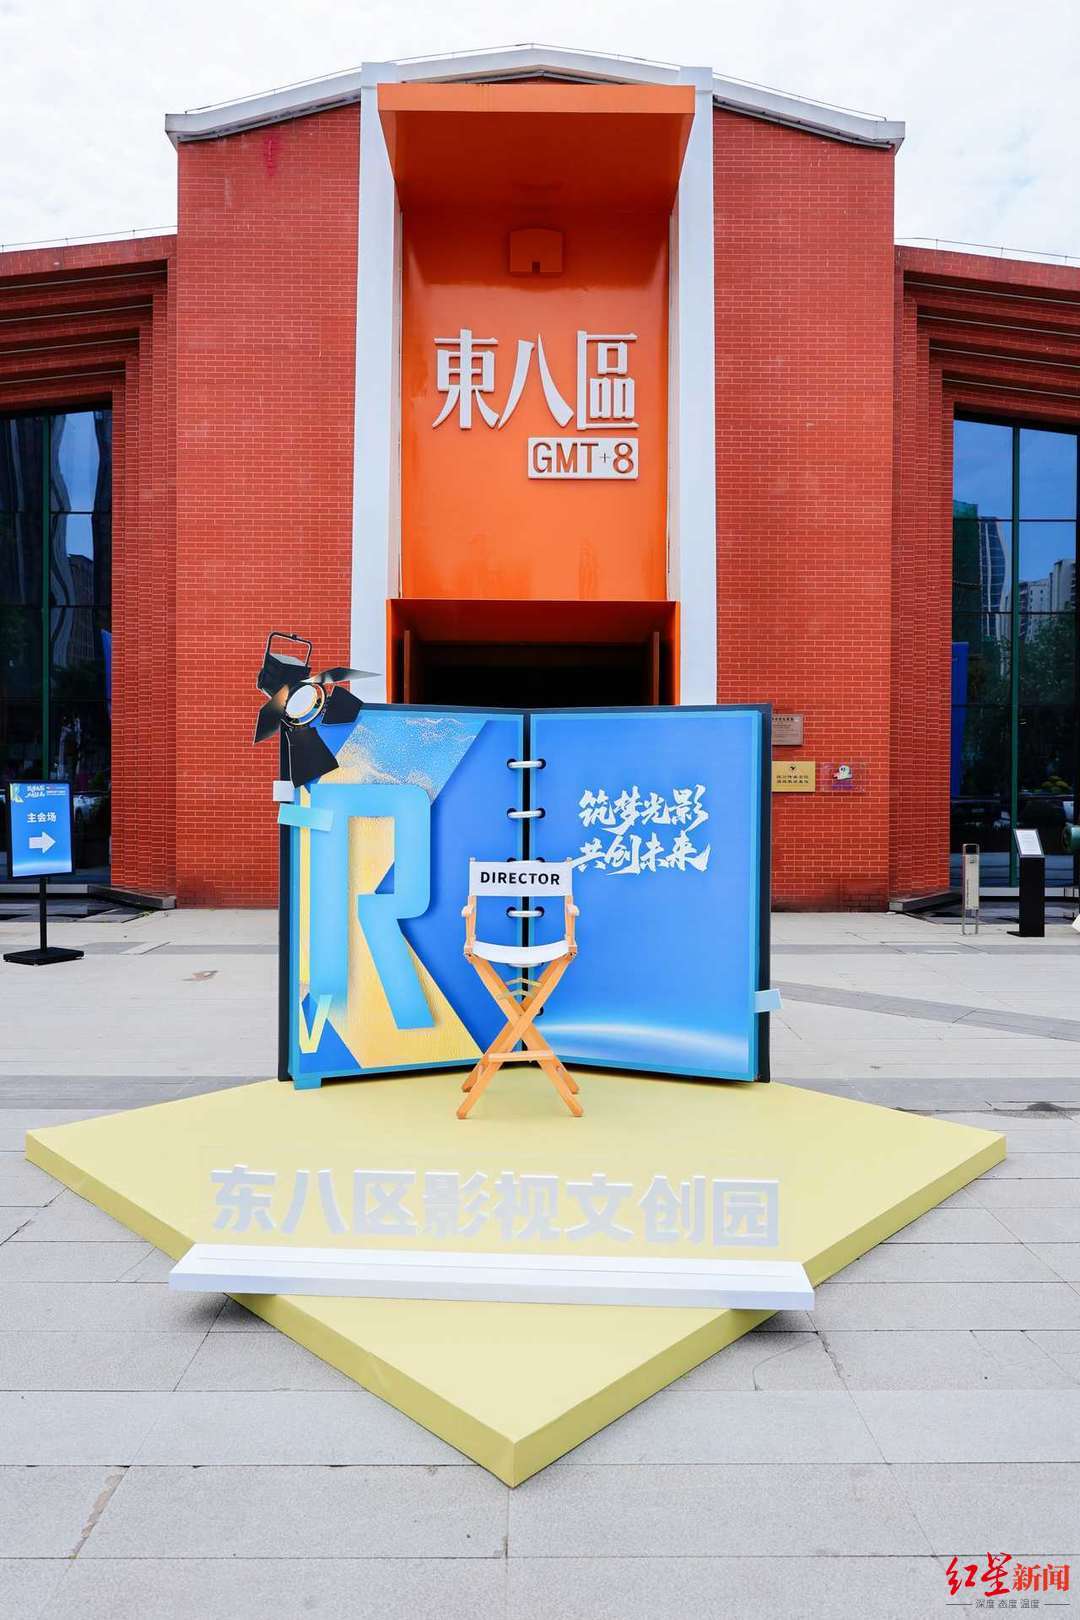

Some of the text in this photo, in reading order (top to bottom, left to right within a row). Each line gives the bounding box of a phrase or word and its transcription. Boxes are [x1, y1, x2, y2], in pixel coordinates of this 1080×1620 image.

[432, 329, 639, 430] 東八區
[532, 441, 635, 473] GMT+8
[27, 812, 57, 823] 主会场
[578, 784, 709, 834] 筑梦光影
[570, 830, 711, 876] 共创未来
[480, 871, 560, 885] DIRECTOR
[210, 1163, 780, 1248] 东八区影视文创园
